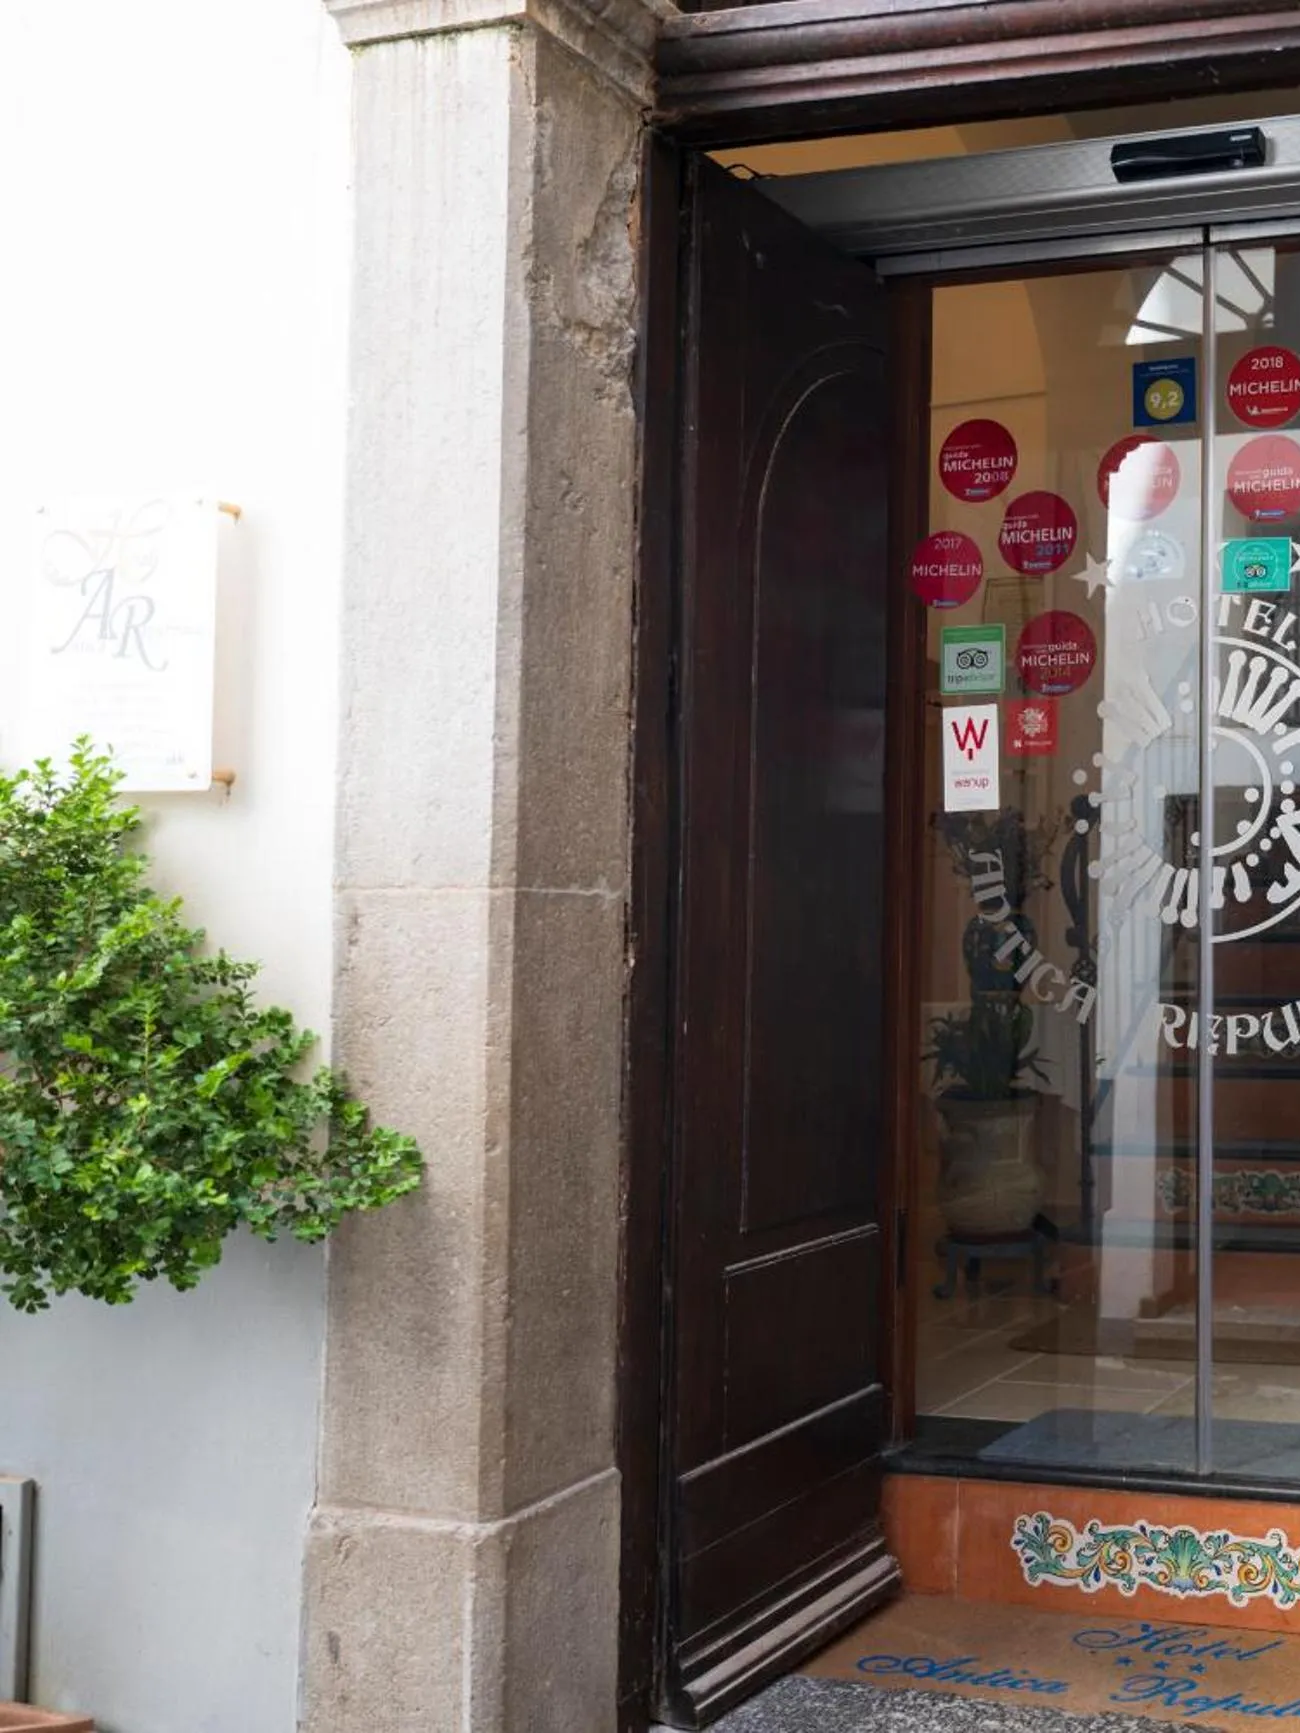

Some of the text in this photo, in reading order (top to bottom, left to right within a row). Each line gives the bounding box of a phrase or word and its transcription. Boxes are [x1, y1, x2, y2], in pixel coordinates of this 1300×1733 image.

[1251, 356, 1284, 370] 2018
[943, 456, 1014, 472] MICHELIN
[1001, 526, 1073, 545] MICHELIN
[912, 563, 982, 577] MICHELIN
[1136, 593, 1298, 651] HOTEL
[1021, 652, 1090, 667] MICHELIN
[968, 848, 1096, 1024] ANTICA
[1073, 1623, 1285, 1661] Hotel
[857, 1655, 1070, 1694] Antica
